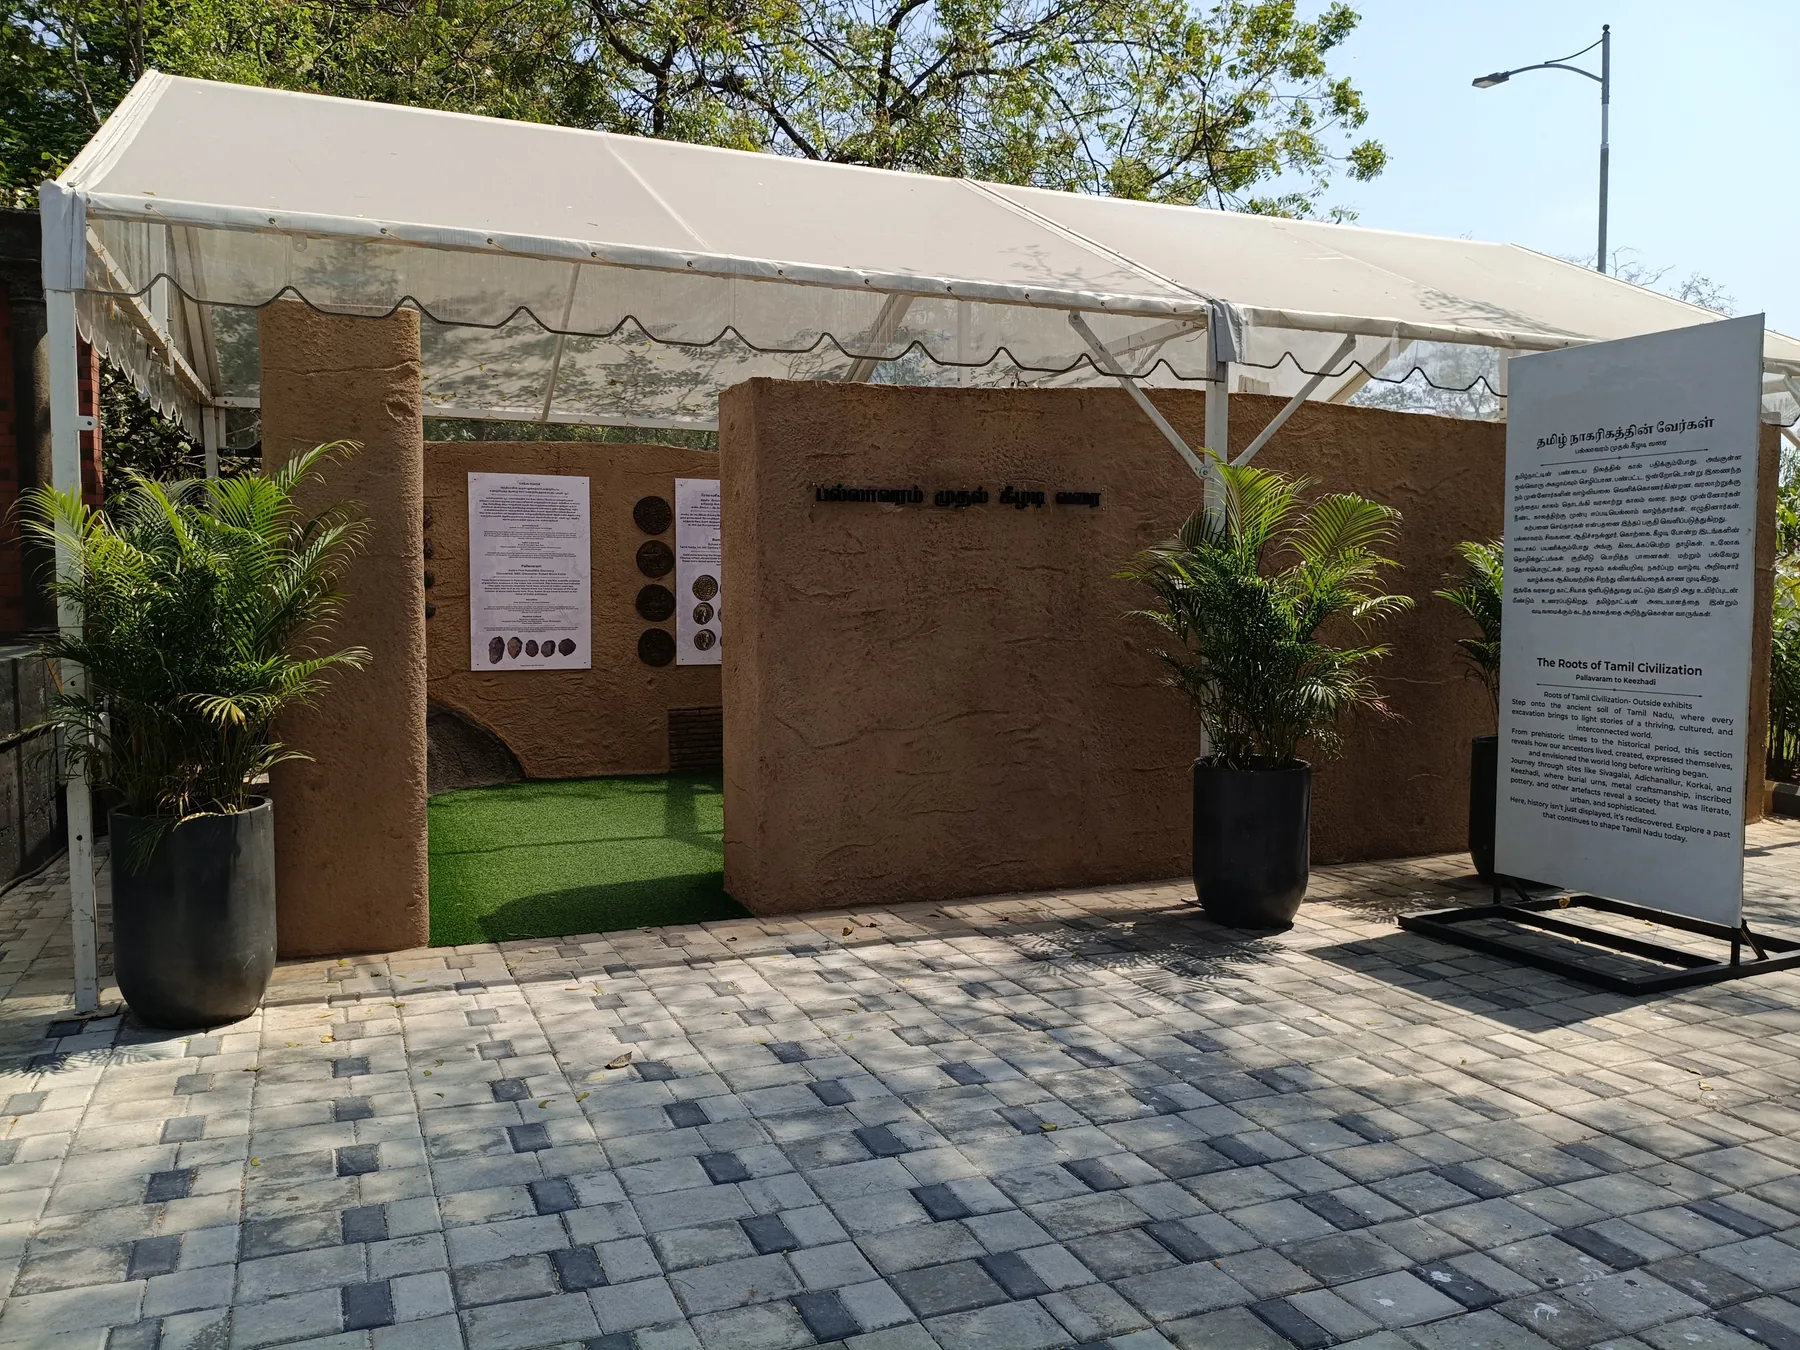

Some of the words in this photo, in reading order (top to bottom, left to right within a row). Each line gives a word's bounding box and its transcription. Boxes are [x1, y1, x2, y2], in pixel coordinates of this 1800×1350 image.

[1537, 433, 1567, 449] தமிழ்
[1570, 424, 1654, 446] நாகரிகத்தின்
[1656, 416, 1714, 434] வேர்கள்
[1575, 445, 1609, 454] பல்லாவரம்
[1610, 443, 1629, 452] முதல்
[1630, 441, 1647, 450] கீழடி
[816, 484, 923, 506] பல்லாவரம்
[935, 486, 988, 508] முதல்
[1000, 486, 1046, 509] கீழடி
[1056, 490, 1102, 508] வரை
[1537, 658, 1556, 667] The
[1558, 659, 1588, 669] Roots
[1590, 660, 1602, 670] of
[1604, 661, 1634, 672] Tamil
[1638, 663, 1702, 676] Civilization
[1576, 674, 1613, 682] Pallavaram
[1623, 677, 1656, 685] Keezhadi
[1544, 691, 1562, 699] Roots
[1591, 695, 1631, 704] Civilization-
[1632, 698, 1661, 707] Outside
[1663, 701, 1692, 709] exhibits
[1548, 712, 1568, 720] brings
[1581, 715, 1597, 723] light
[1600, 717, 1623, 725] stories
[1645, 721, 1675, 731] thriving,
[1679, 725, 1714, 735] cultured,
[1626, 708, 1646, 716] Tamil
[1653, 711, 1674, 720] Nadu,
[1680, 714, 1705, 722] where
[1712, 717, 1734, 725] every
[1577, 724, 1629, 736] interconnected
[1531, 731, 1565, 740] prehistoric
[1568, 734, 1587, 742] times
[1618, 740, 1650, 749] historical
[1654, 744, 1680, 753] period,
[1685, 747, 1699, 755] this
[1704, 750, 1732, 758] section
[1542, 752, 1576, 761] envisioned
[1612, 760, 1627, 769] long
[1629, 762, 1652, 771] before
[1654, 766, 1680, 776] writing
[1682, 769, 1708, 778] began.
[1562, 745, 1594, 753] ancestors
[1596, 747, 1614, 756] lived,
[1615, 751, 1644, 760] created,
[1646, 755, 1684, 764] expressed
[1685, 758, 1732, 771] themselves,
[1510, 757, 1535, 767] Journey
[1538, 761, 1564, 771] through
[1599, 769, 1632, 780] Sivagalai,
[1634, 774, 1683, 787] Adichanallur,
[1686, 781, 1715, 791] Korkai,
[1511, 767, 1540, 777] Keezhadi,
[1544, 772, 1564, 780] where
[1568, 775, 1586, 783] burial
[1611, 782, 1632, 790] metal
[1636, 786, 1690, 799] craftsmanship,
[1695, 792, 1731, 804] inscribed
[1510, 778, 1534, 786] pottery,
[1571, 787, 1601, 796] artefacts
[1634, 796, 1661, 806] society
[1664, 800, 1679, 808] that
[1701, 805, 1731, 816] literate,
[1570, 797, 1591, 805] urban,
[1607, 803, 1656, 815] sophisticated.
[1510, 796, 1526, 805] Here,
[1527, 799, 1549, 809] history
[1550, 802, 1563, 811] isn't
[1564, 805, 1577, 813] just
[1578, 808, 1612, 819] displayed,
[1614, 812, 1624, 820] it's
[1626, 816, 1674, 829] rediscovered.
[1676, 823, 1704, 834] Explore
[1557, 815, 1590, 825] continues
[1600, 821, 1620, 830] shape
[1622, 825, 1641, 834] Tamil
[1643, 829, 1662, 838] Nadu
[1664, 833, 1687, 843] today.
